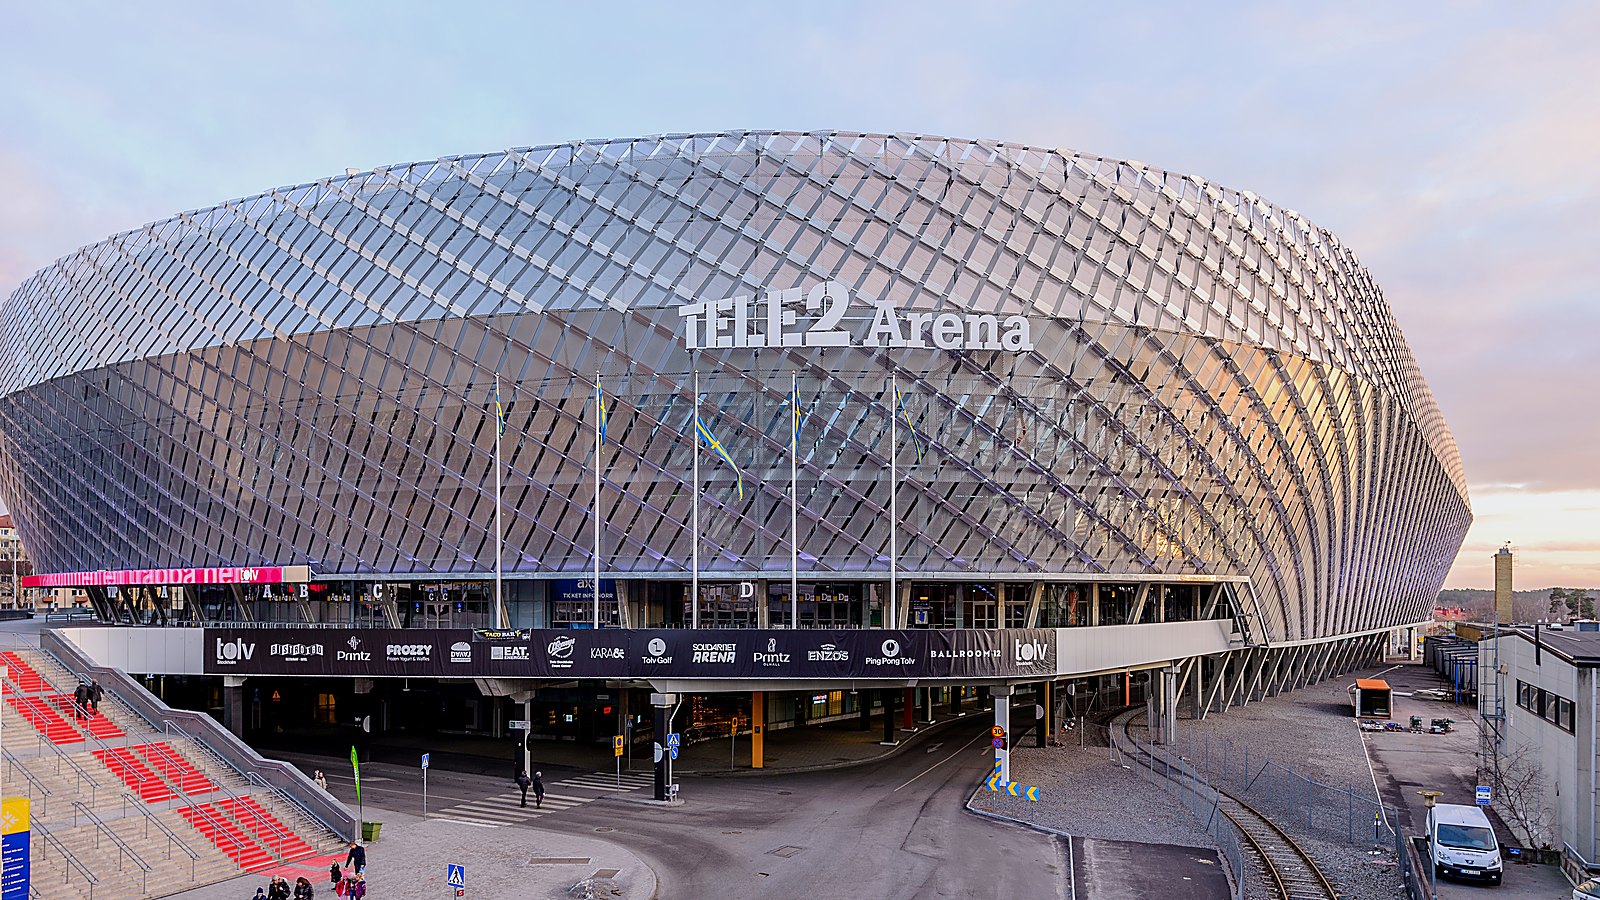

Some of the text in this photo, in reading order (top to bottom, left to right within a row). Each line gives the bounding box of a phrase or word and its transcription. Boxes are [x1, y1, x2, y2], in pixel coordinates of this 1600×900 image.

[678, 281, 1034, 351] TELE2 Arena
[107, 586, 118, 598] VIP
[263, 584, 272, 598] A
[299, 584, 309, 598] B
[741, 582, 754, 598] D
[216, 638, 255, 660] tolv
[386, 644, 432, 656] FROZZY
[930, 650, 990, 658] BALLROOM
[1015, 639, 1048, 661] tolv
[337, 650, 371, 661] Printz
[642, 656, 672, 664] Tolv Golf
[692, 651, 736, 663] ARENA
[753, 652, 790, 663] Printz
[865, 657, 915, 666] Ping Pong Tolv
